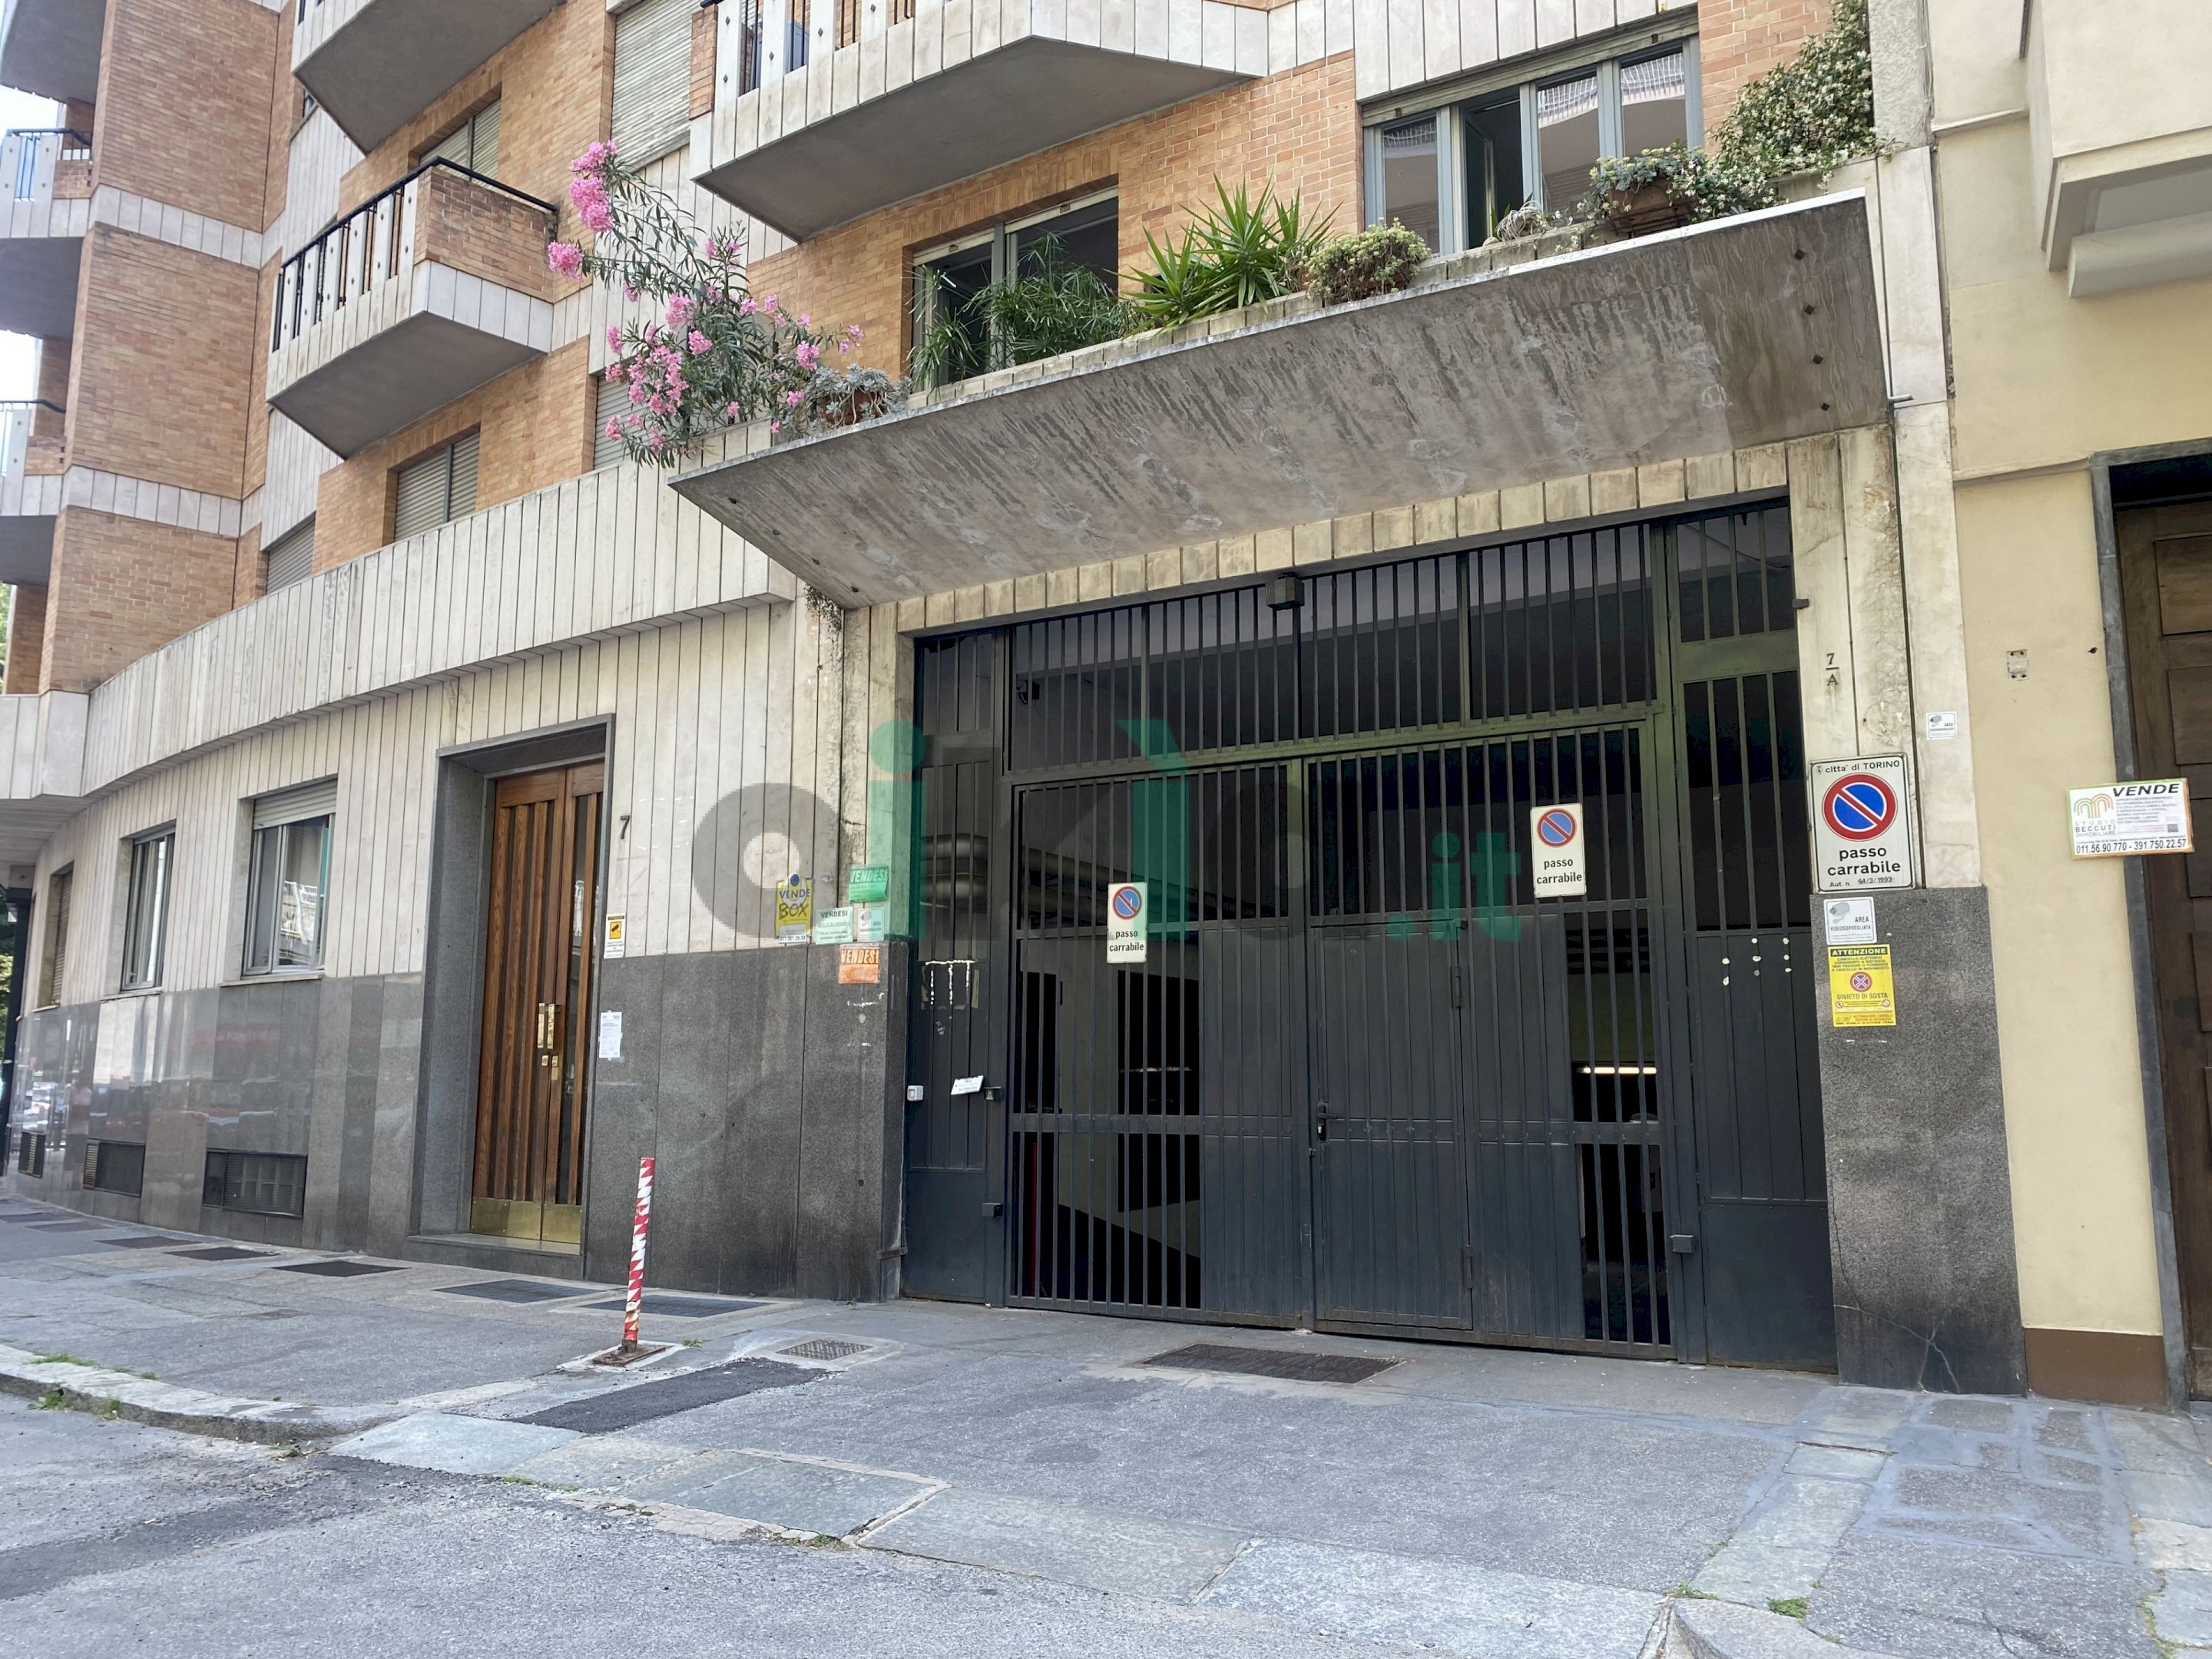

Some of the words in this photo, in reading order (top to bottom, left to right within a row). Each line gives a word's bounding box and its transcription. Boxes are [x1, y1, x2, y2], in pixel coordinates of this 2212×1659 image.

[1826, 653, 1835, 665] 7
[1827, 674, 1838, 686] A
[1863, 760, 1900, 770] TORINO
[2113, 783, 2180, 797] VENDE
[620, 815, 631, 839] 7
[2075, 824, 2115, 833] BECCUTI
[2076, 842, 2127, 854] 011.56.90.770
[2134, 839, 2187, 850] 391.750.22.57
[1839, 847, 1887, 861] passo
[1544, 859, 1573, 870] passo
[1828, 861, 1901, 876] carrabile
[850, 869, 888, 883] VENDESI
[1537, 873, 1582, 884] carrabile
[779, 889, 810, 899] VENDE
[779, 902, 809, 919] BOX
[821, 910, 848, 919] VENDESI
[1116, 930, 1138, 939] passo
[1110, 942, 1144, 952] carrabile
[1832, 948, 1886, 956] ATTENZIONE
[841, 949, 879, 964] VENDESI
